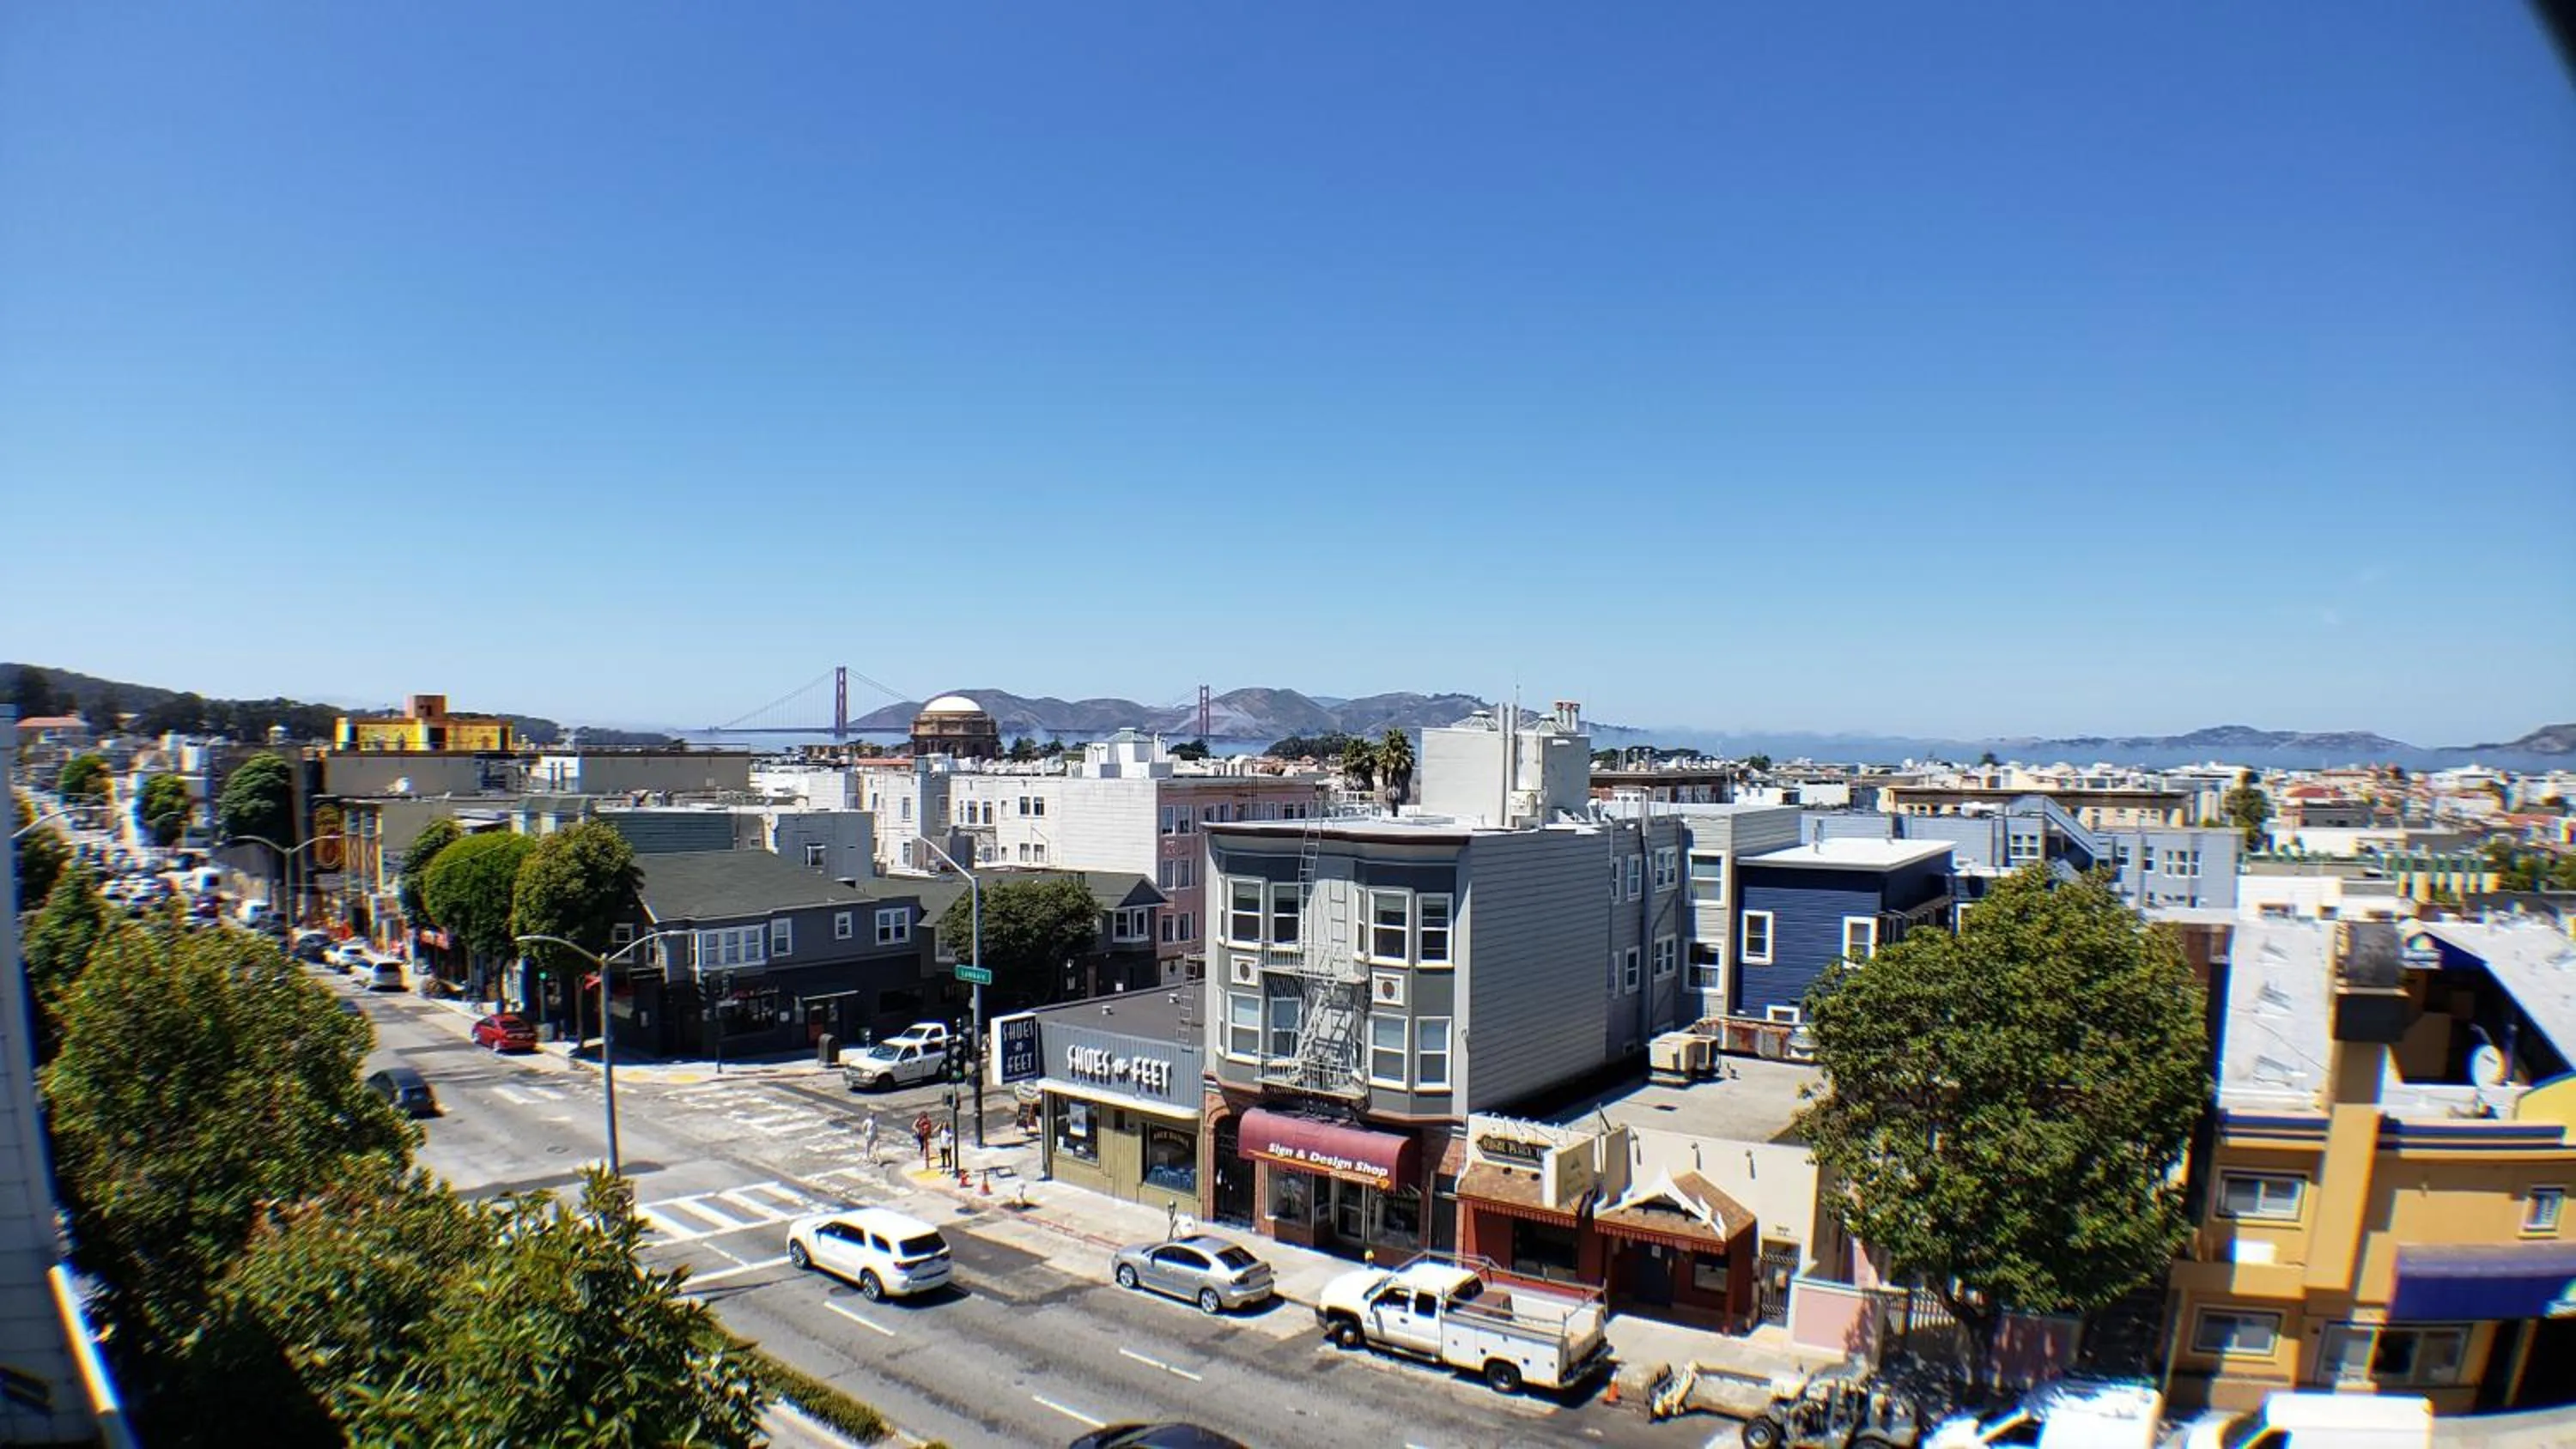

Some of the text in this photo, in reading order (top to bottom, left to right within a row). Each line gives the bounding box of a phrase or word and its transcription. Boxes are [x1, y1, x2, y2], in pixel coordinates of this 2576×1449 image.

[1003, 1020, 1034, 1042] SHOES
[1007, 1052, 1033, 1072] FEET
[1067, 1044, 1110, 1076] SHOES
[1130, 1056, 1170, 1088] FEET
[1268, 1142, 1293, 1158] Sign
[1296, 1149, 1306, 1160] &
[1309, 1151, 1352, 1170] Design
[1355, 1160, 1388, 1179] Shop
